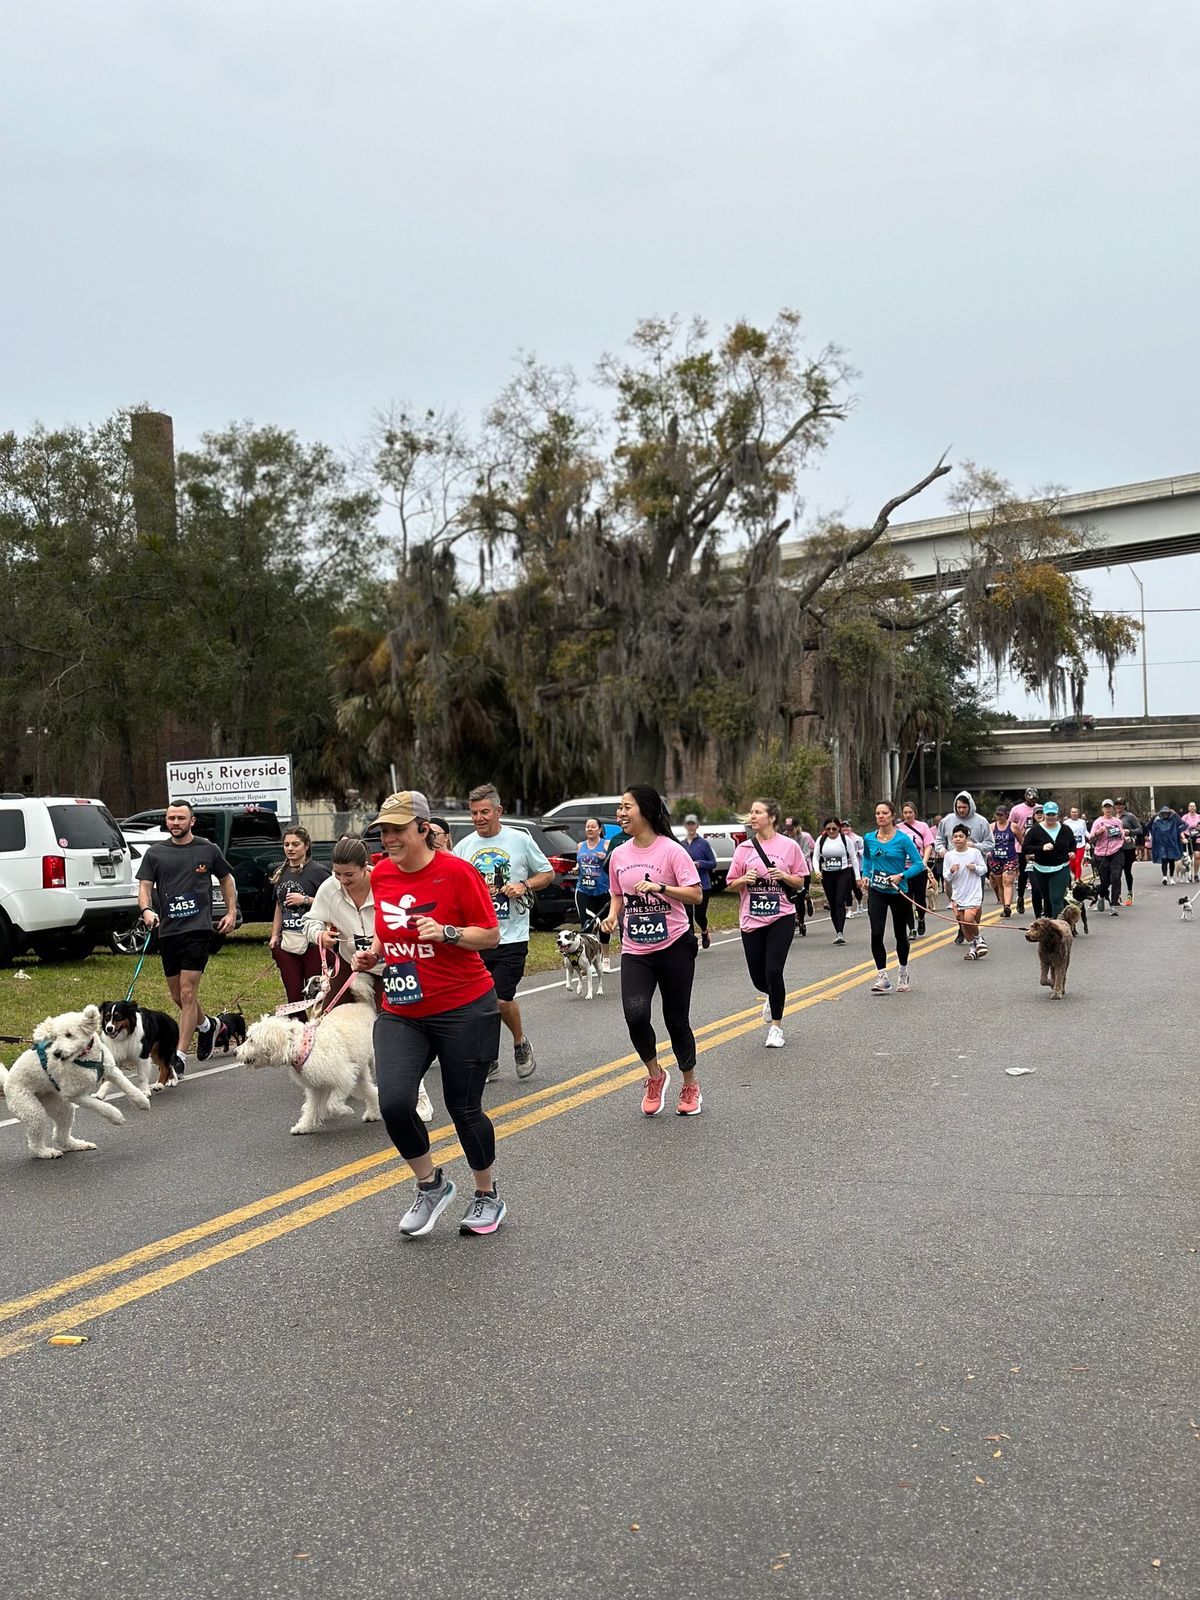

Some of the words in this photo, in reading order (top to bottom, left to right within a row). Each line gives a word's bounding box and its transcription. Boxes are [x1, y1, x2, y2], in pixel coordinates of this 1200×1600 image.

[169, 767, 213, 783] Hugh's
[220, 762, 287, 778] Riverside
[196, 778, 261, 792] Automotive
[247, 793, 267, 801] Repair
[169, 899, 196, 912] 3453
[492, 901, 509, 911] 04
[644, 904, 670, 913] SOCIAL
[751, 900, 778, 910] 3467
[630, 922, 665, 935] 3424
[383, 942, 435, 959] RWB
[383, 974, 418, 993] 3408
